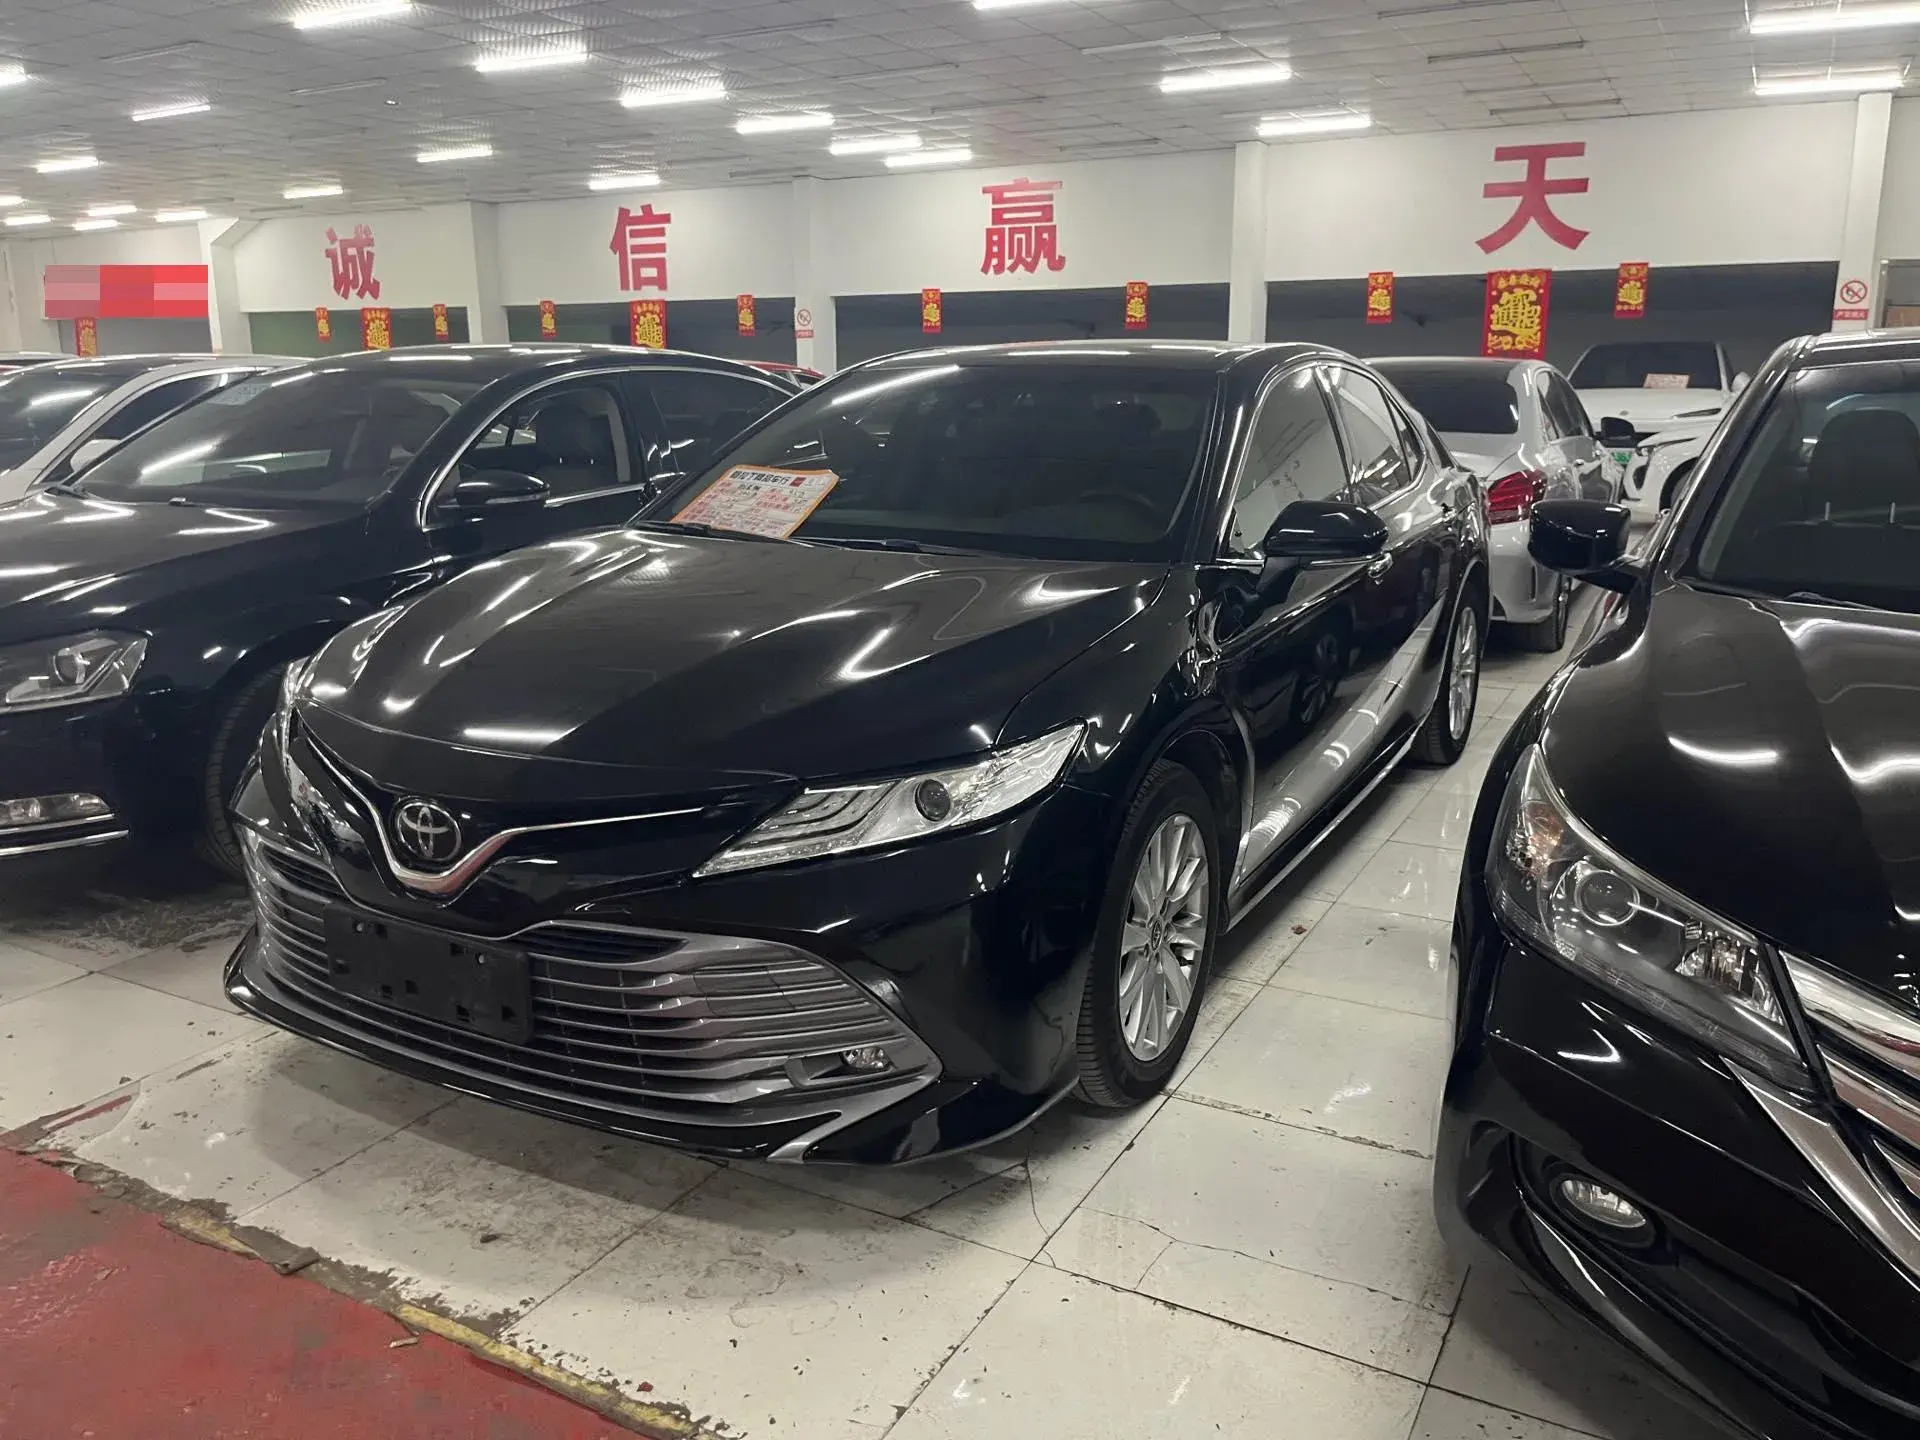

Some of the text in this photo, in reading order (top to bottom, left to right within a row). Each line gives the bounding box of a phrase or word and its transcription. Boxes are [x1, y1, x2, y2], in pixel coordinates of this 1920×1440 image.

[325, 142, 1590, 299] 诚 信 赢 天
